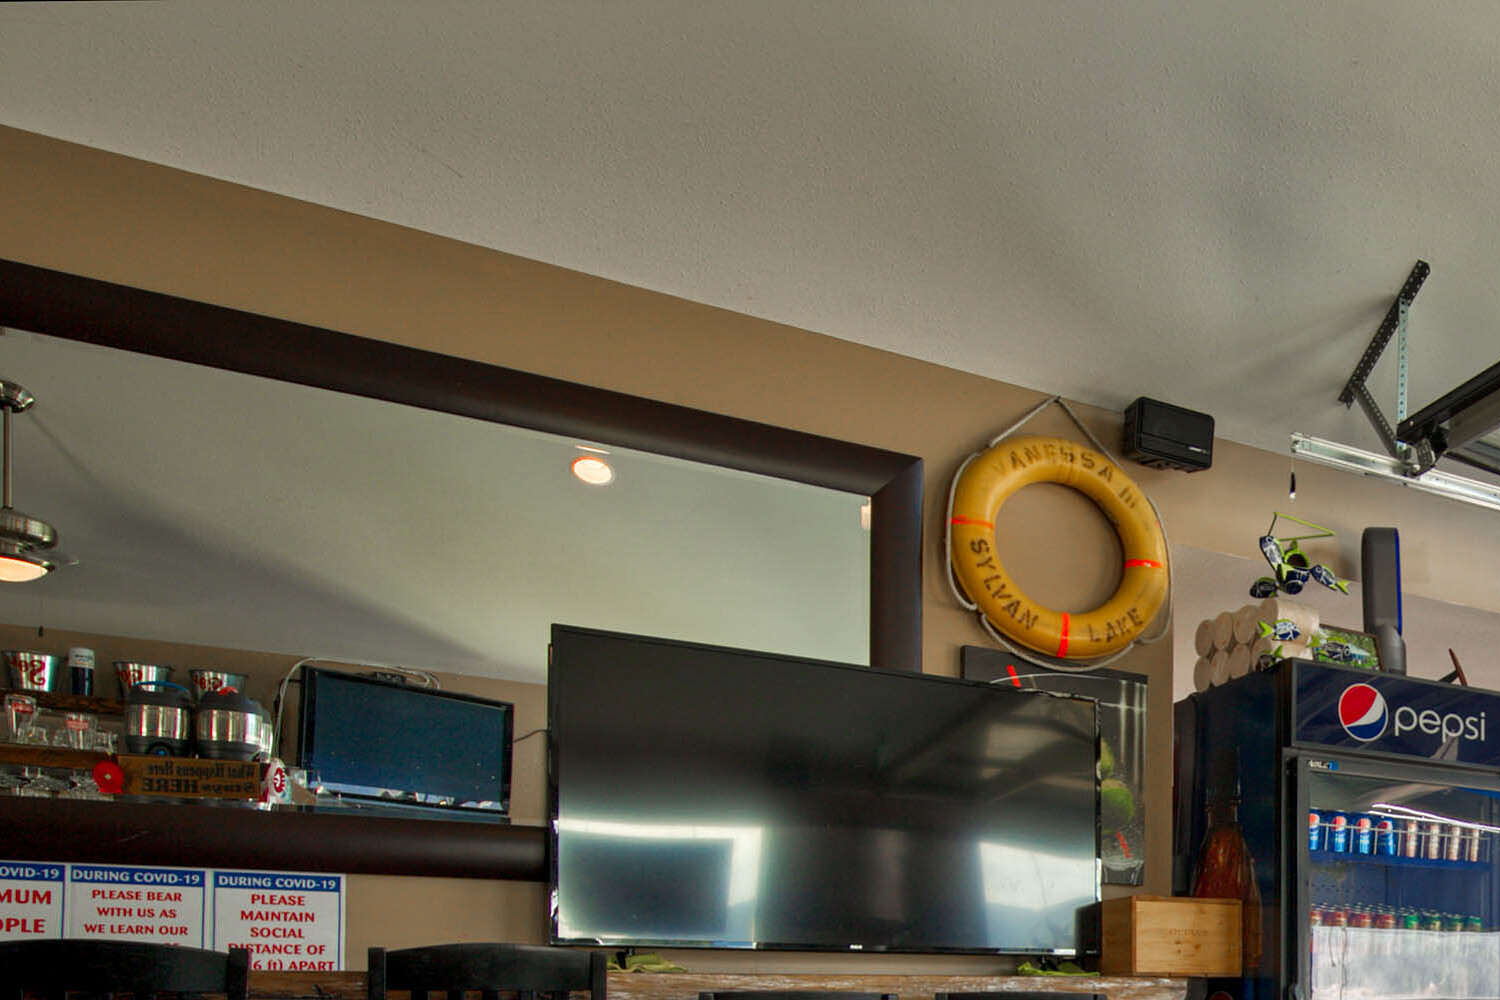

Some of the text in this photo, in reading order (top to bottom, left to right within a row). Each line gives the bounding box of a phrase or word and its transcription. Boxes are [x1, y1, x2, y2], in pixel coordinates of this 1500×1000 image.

[969, 538, 1144, 643] SYLVAN LAKE
[1394, 706, 1487, 744] pepsi
[0, 866, 59, 879] OVID-19
[72, 869, 200, 884] DURING COVID-19
[218, 875, 336, 889] DURING COVID-19
[0, 888, 52, 905] MUM
[92, 889, 183, 902] PLEASE BEAR
[251, 894, 306, 906] PLEASE
[96, 907, 177, 919] WITH US AS
[240, 910, 315, 923] MAINTAIN
[0, 918, 46, 934] PLE
[84, 924, 188, 936] WE LEARN OUR
[250, 927, 305, 939] SOCIAL
[306, 944, 326, 955] OF
[288, 961, 336, 972] APART
